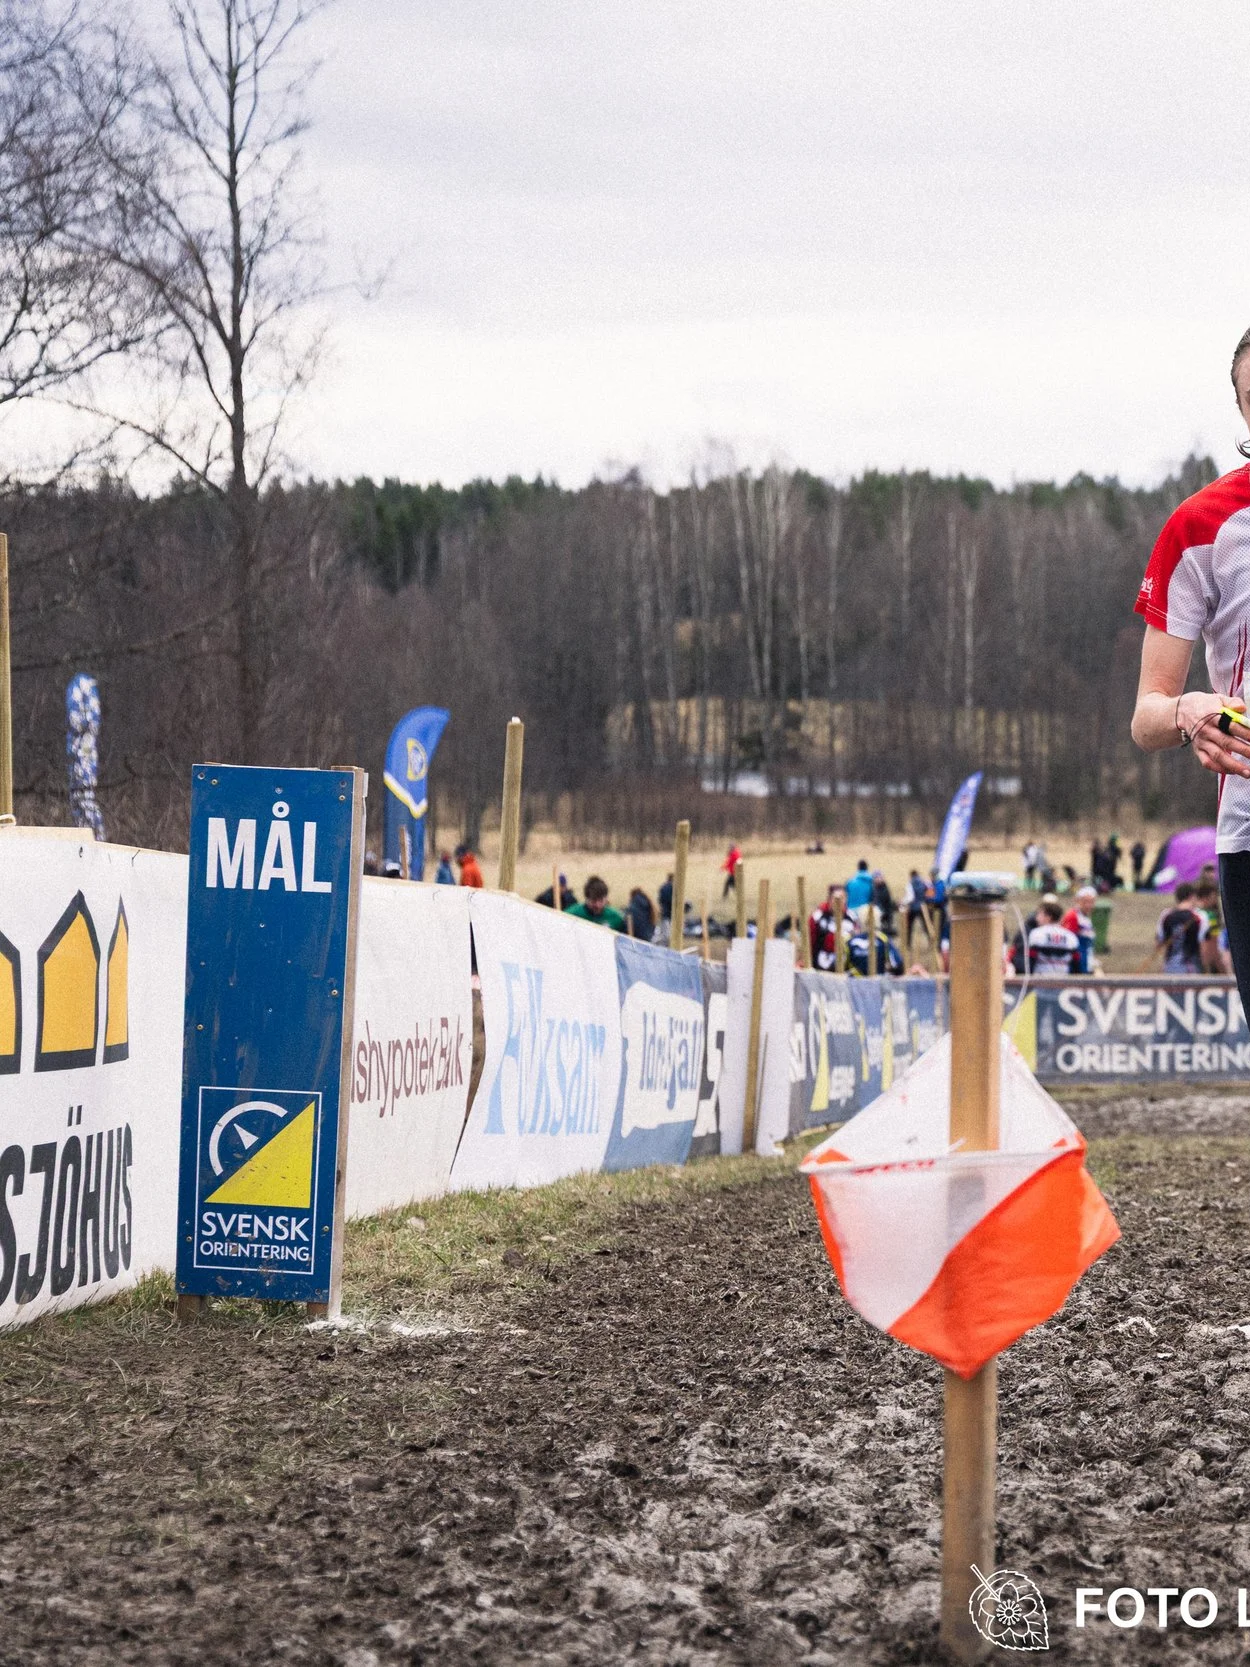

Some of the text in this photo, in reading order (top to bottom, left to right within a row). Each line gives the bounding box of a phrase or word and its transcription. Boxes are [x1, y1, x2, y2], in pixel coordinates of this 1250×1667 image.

[206, 801, 332, 893] MÅL
[201, 1211, 310, 1242] SVENSK
[200, 1241, 310, 1262] ORIENTERING
